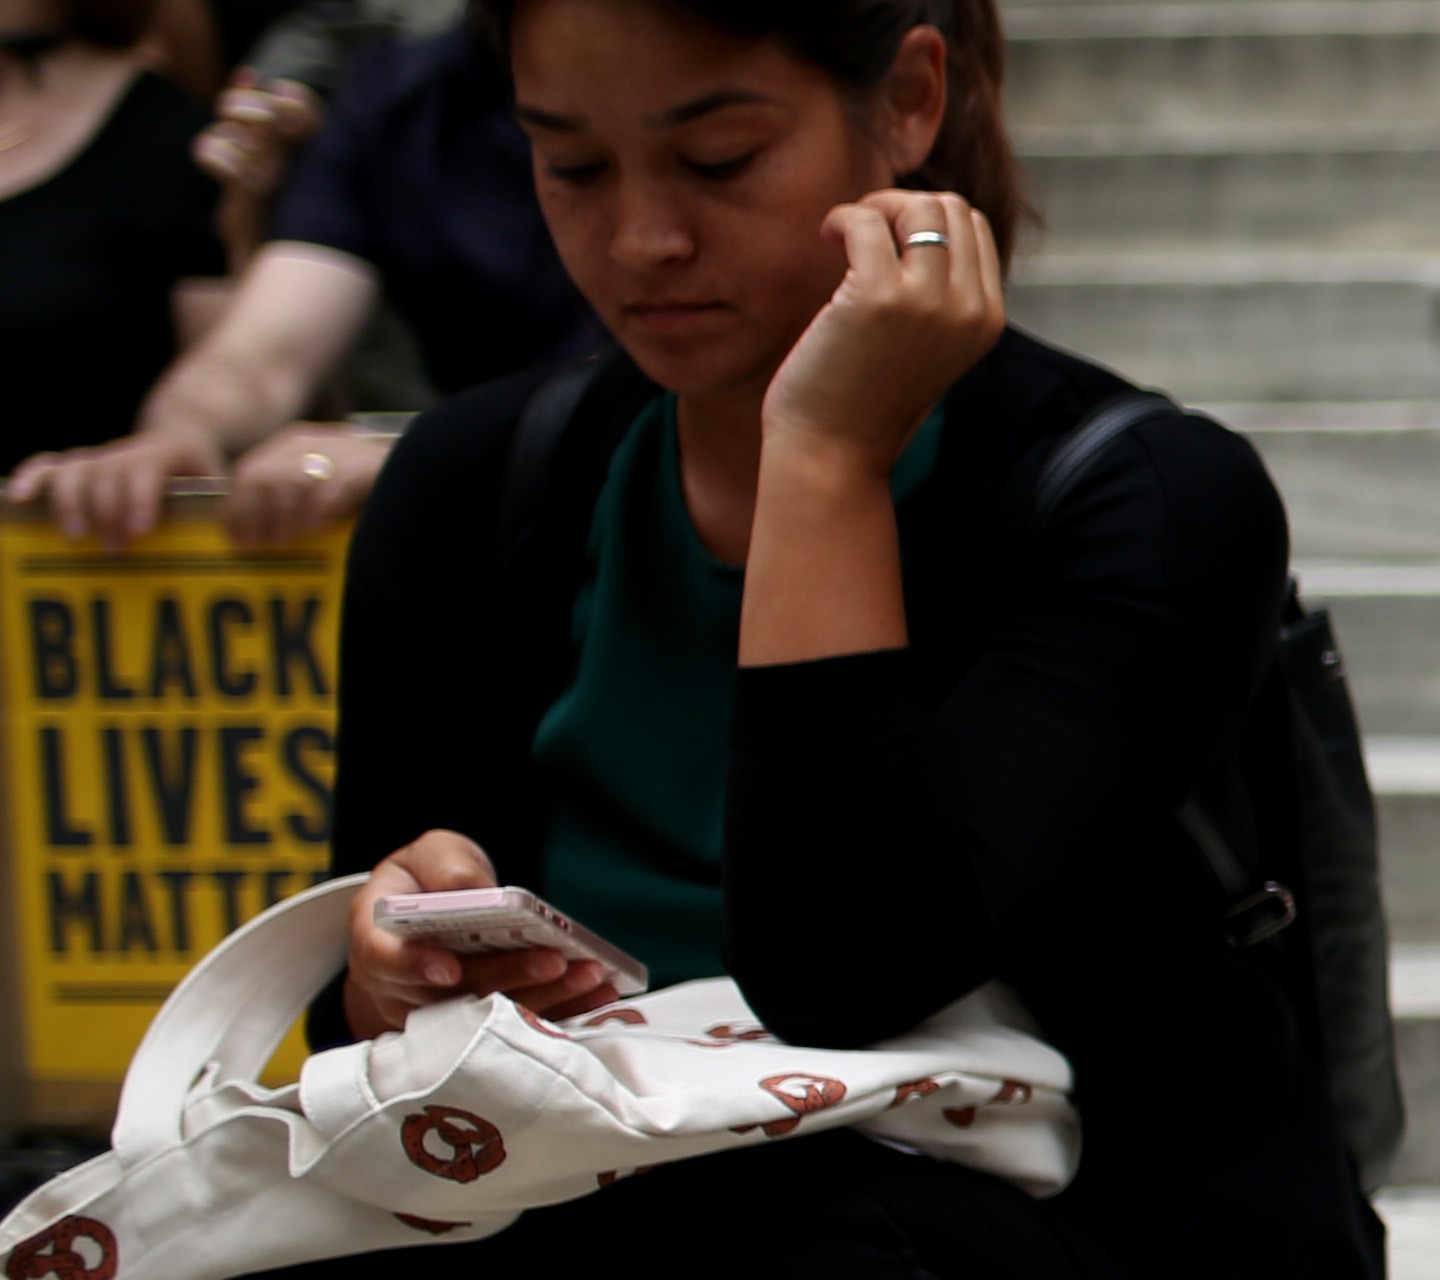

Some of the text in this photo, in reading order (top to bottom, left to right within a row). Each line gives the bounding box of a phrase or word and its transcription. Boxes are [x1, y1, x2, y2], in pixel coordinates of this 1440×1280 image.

[29, 597, 328, 698] BLACK
[40, 726, 336, 846] LIVES
[47, 870, 330, 954] MATT
